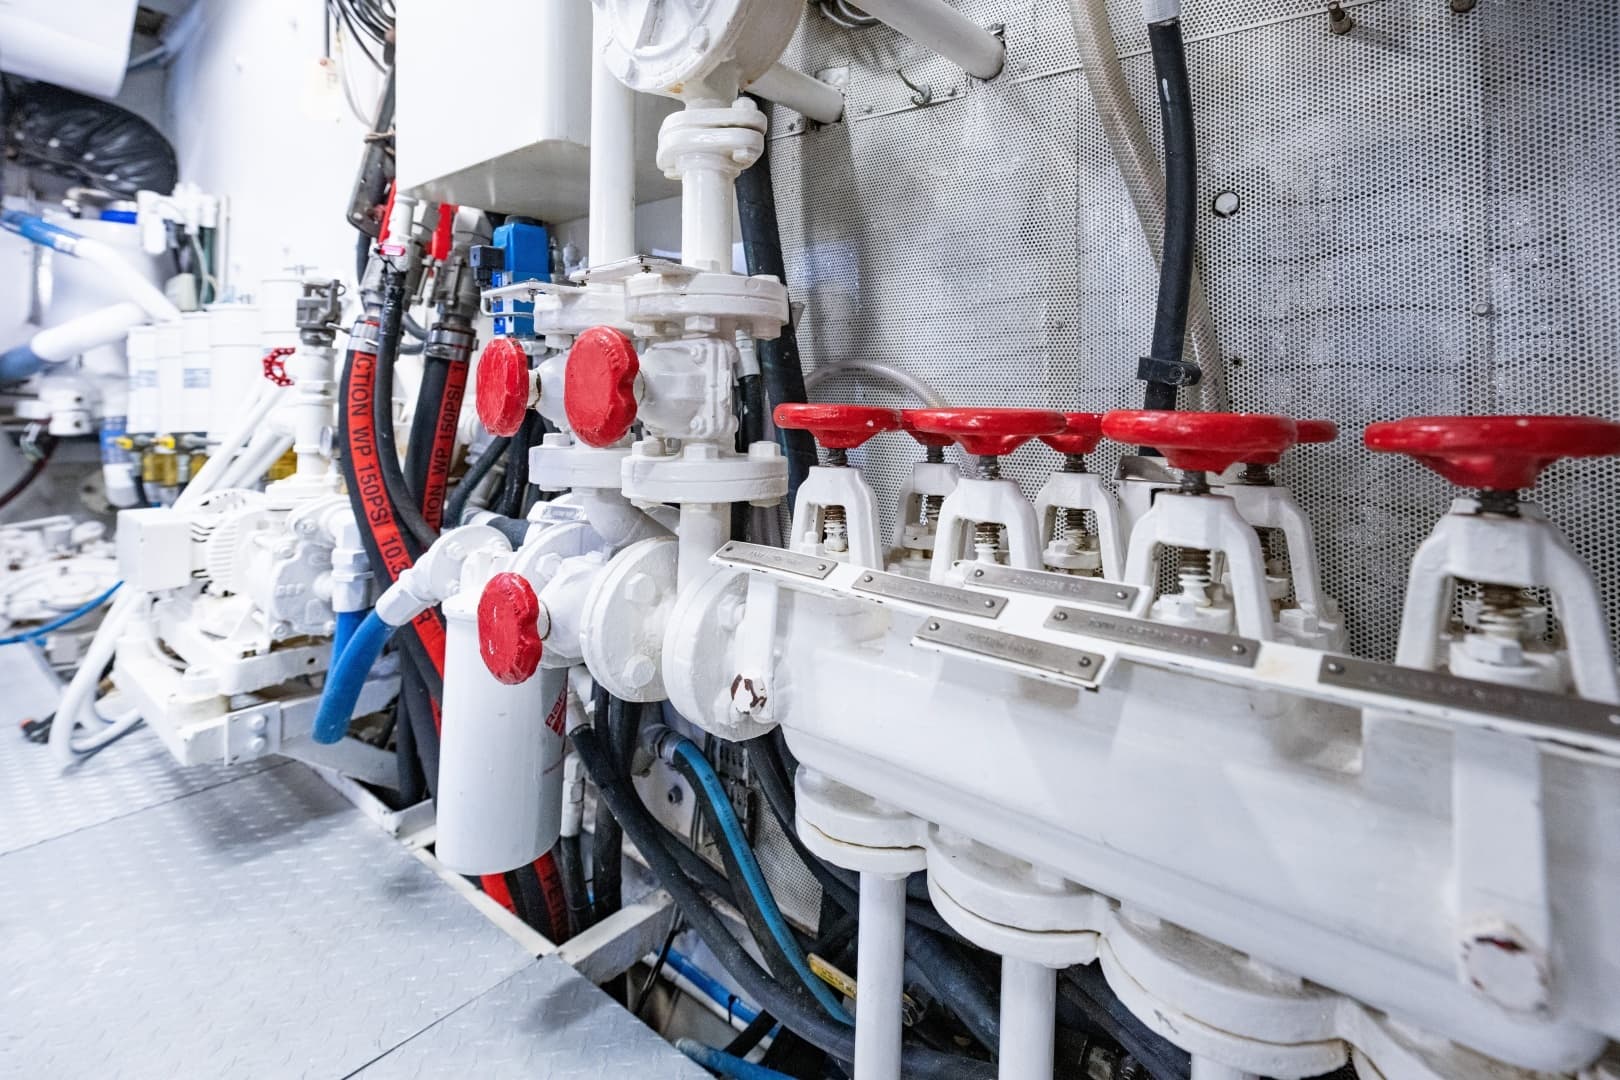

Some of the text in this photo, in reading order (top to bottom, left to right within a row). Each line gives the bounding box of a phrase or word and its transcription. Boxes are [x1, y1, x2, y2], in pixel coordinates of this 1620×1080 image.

[352, 355, 372, 416] CTION
[439, 384, 462, 441] 150PSI
[352, 425, 371, 456] WP
[432, 450, 449, 475] WP
[357, 463, 390, 527] 150PSI
[426, 485, 442, 526] TION
